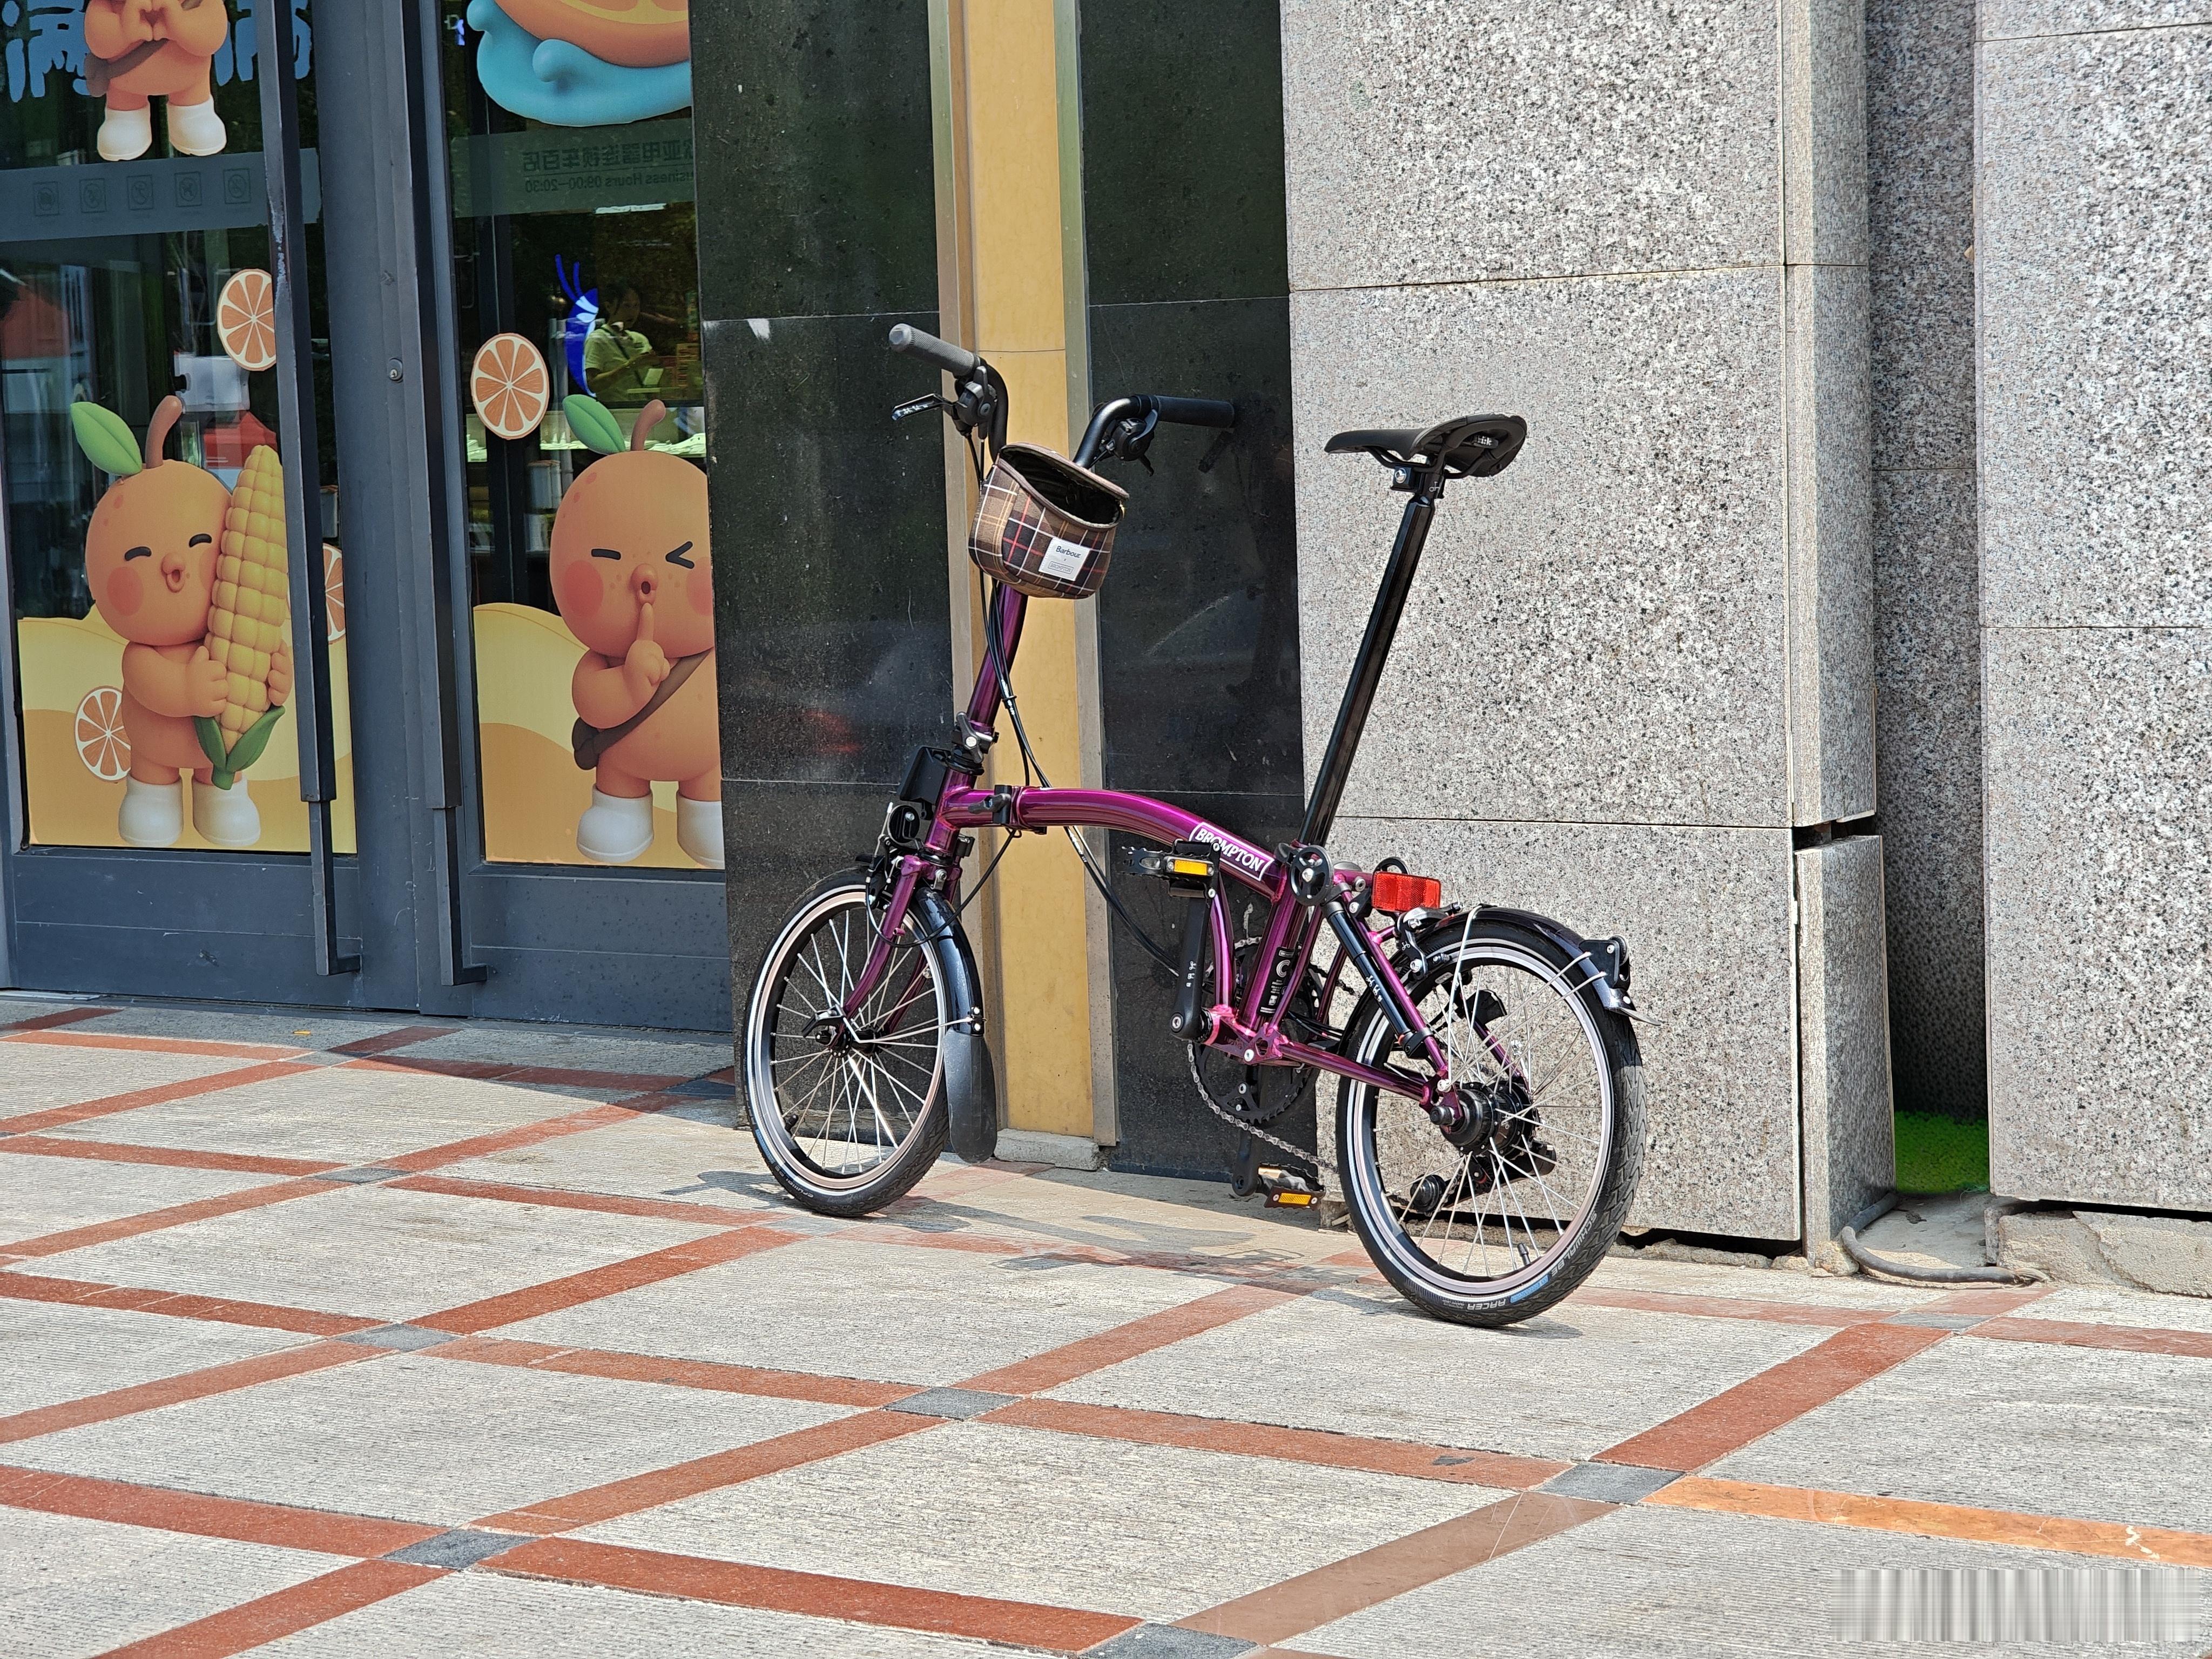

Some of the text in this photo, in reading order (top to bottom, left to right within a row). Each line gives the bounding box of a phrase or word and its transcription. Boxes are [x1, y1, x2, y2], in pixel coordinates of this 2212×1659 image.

[1055, 545, 1082, 558] Barbour
[1551, 1210, 1597, 1277] SCHWALBE
[1467, 1298, 1506, 1311] RACER
